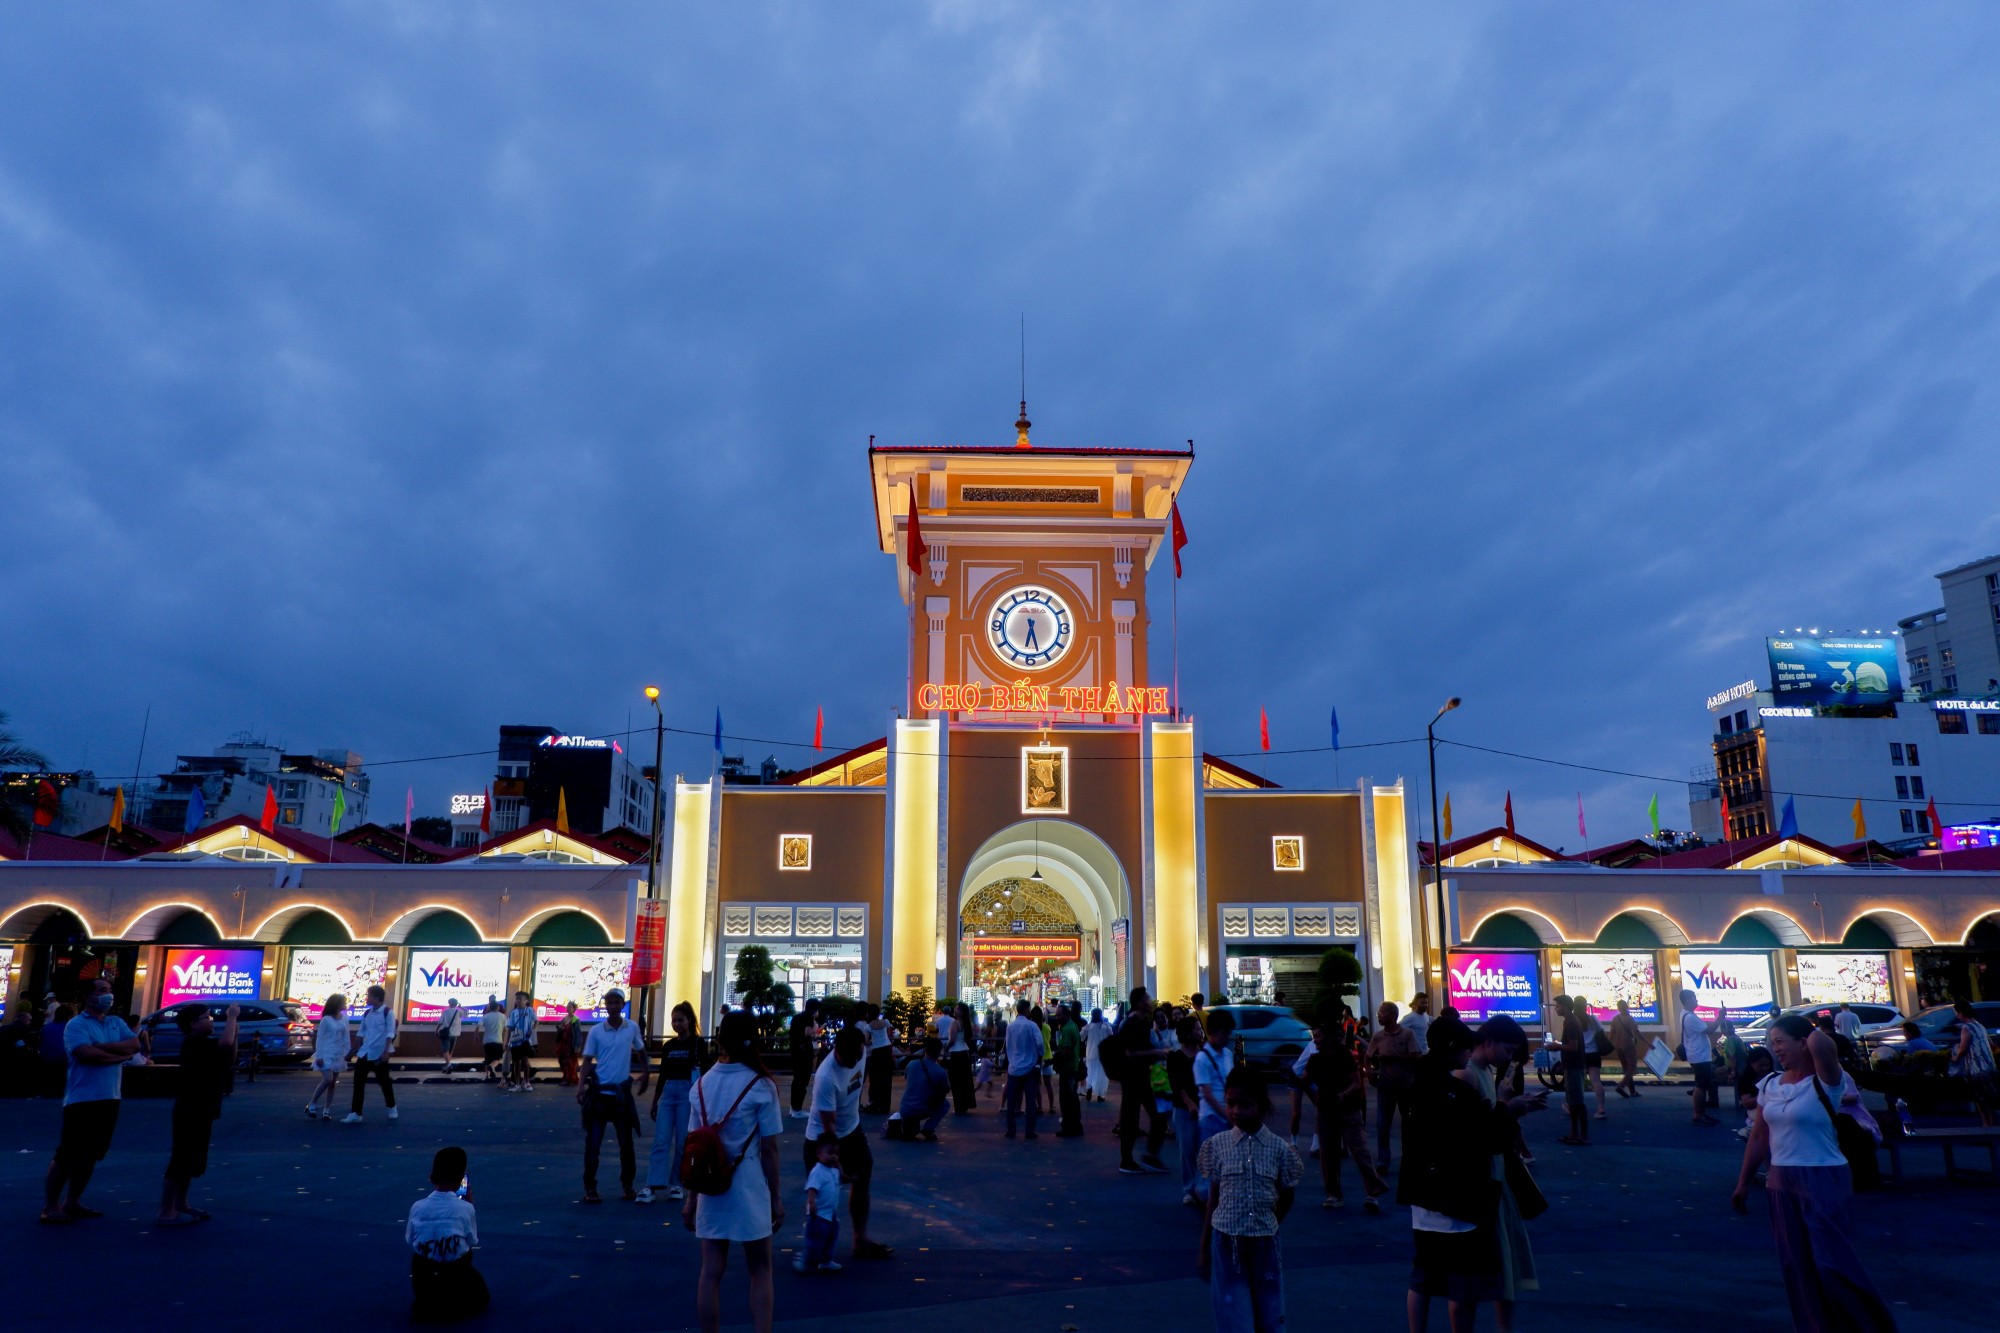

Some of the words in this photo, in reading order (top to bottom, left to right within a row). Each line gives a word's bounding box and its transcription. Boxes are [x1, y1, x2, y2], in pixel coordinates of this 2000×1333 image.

[1023, 590, 1040, 601] 12
[992, 620, 1002, 632] 9
[1060, 623, 1070, 634] 3
[1026, 656, 1036, 666] 6
[1826, 662, 1888, 694] 30
[918, 681, 981, 714] CHỢ
[990, 677, 1050, 712] BẾN
[1060, 681, 1168, 714] THÀNH
[1730, 680, 1757, 700] HOTEL
[1936, 700, 1970, 709] HOTEL
[1981, 701, 1999, 709] LAC
[1759, 708, 1792, 716] OZONE
[1794, 708, 1813, 716] BAR
[539, 735, 585, 746] AVANTI
[451, 804, 470, 814] SPA
[298, 956, 314, 965] Vikki
[542, 957, 558, 966] Vikki
[1566, 960, 1582, 968] Vikki
[1801, 960, 1816, 969] Vikki
[172, 955, 228, 987] Vikki
[420, 958, 472, 987] Vikki
[1451, 959, 1505, 990] Vikki
[1686, 962, 1737, 989] Vikki
[228, 978, 254, 987] Bank
[1506, 981, 1531, 990] Bank
